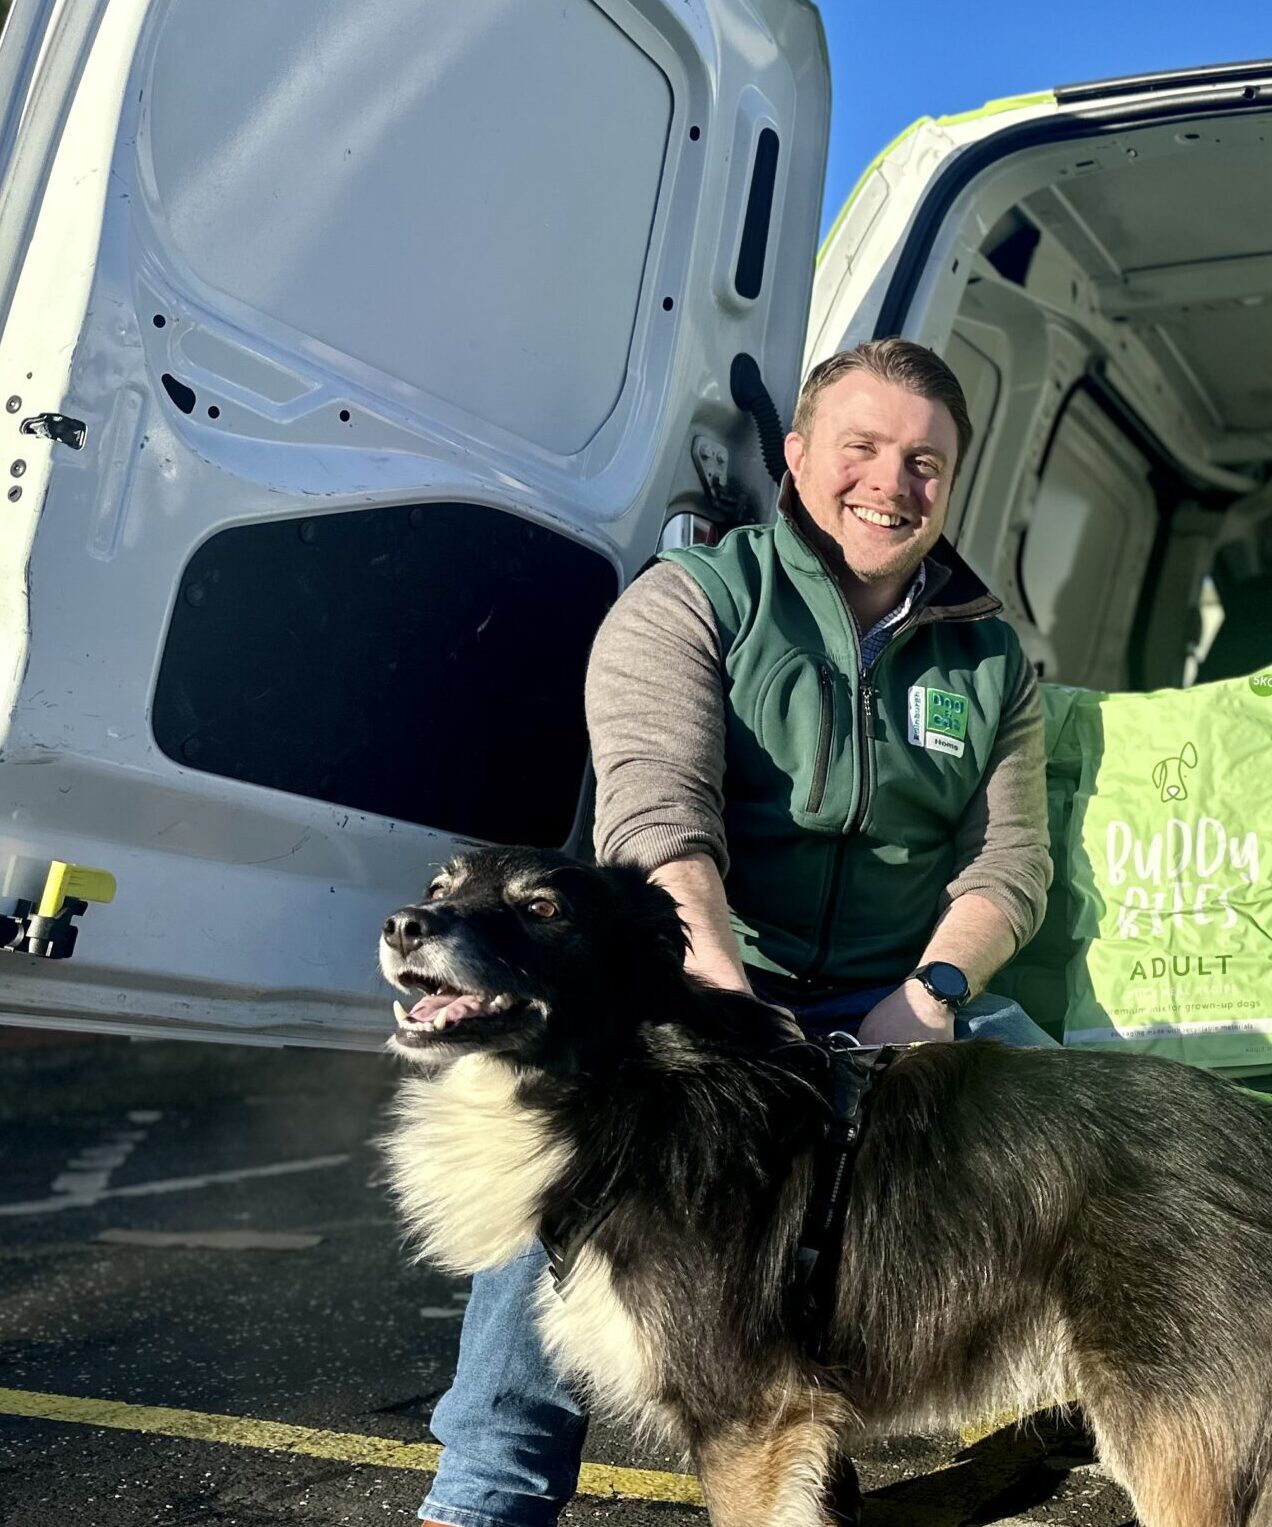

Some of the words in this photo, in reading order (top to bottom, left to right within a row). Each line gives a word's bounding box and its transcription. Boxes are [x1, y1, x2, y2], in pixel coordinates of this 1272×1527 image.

[1129, 954, 1233, 981] ADULT
[1185, 1000, 1233, 1014] grown-up
[1236, 999, 1261, 1010] dogs
